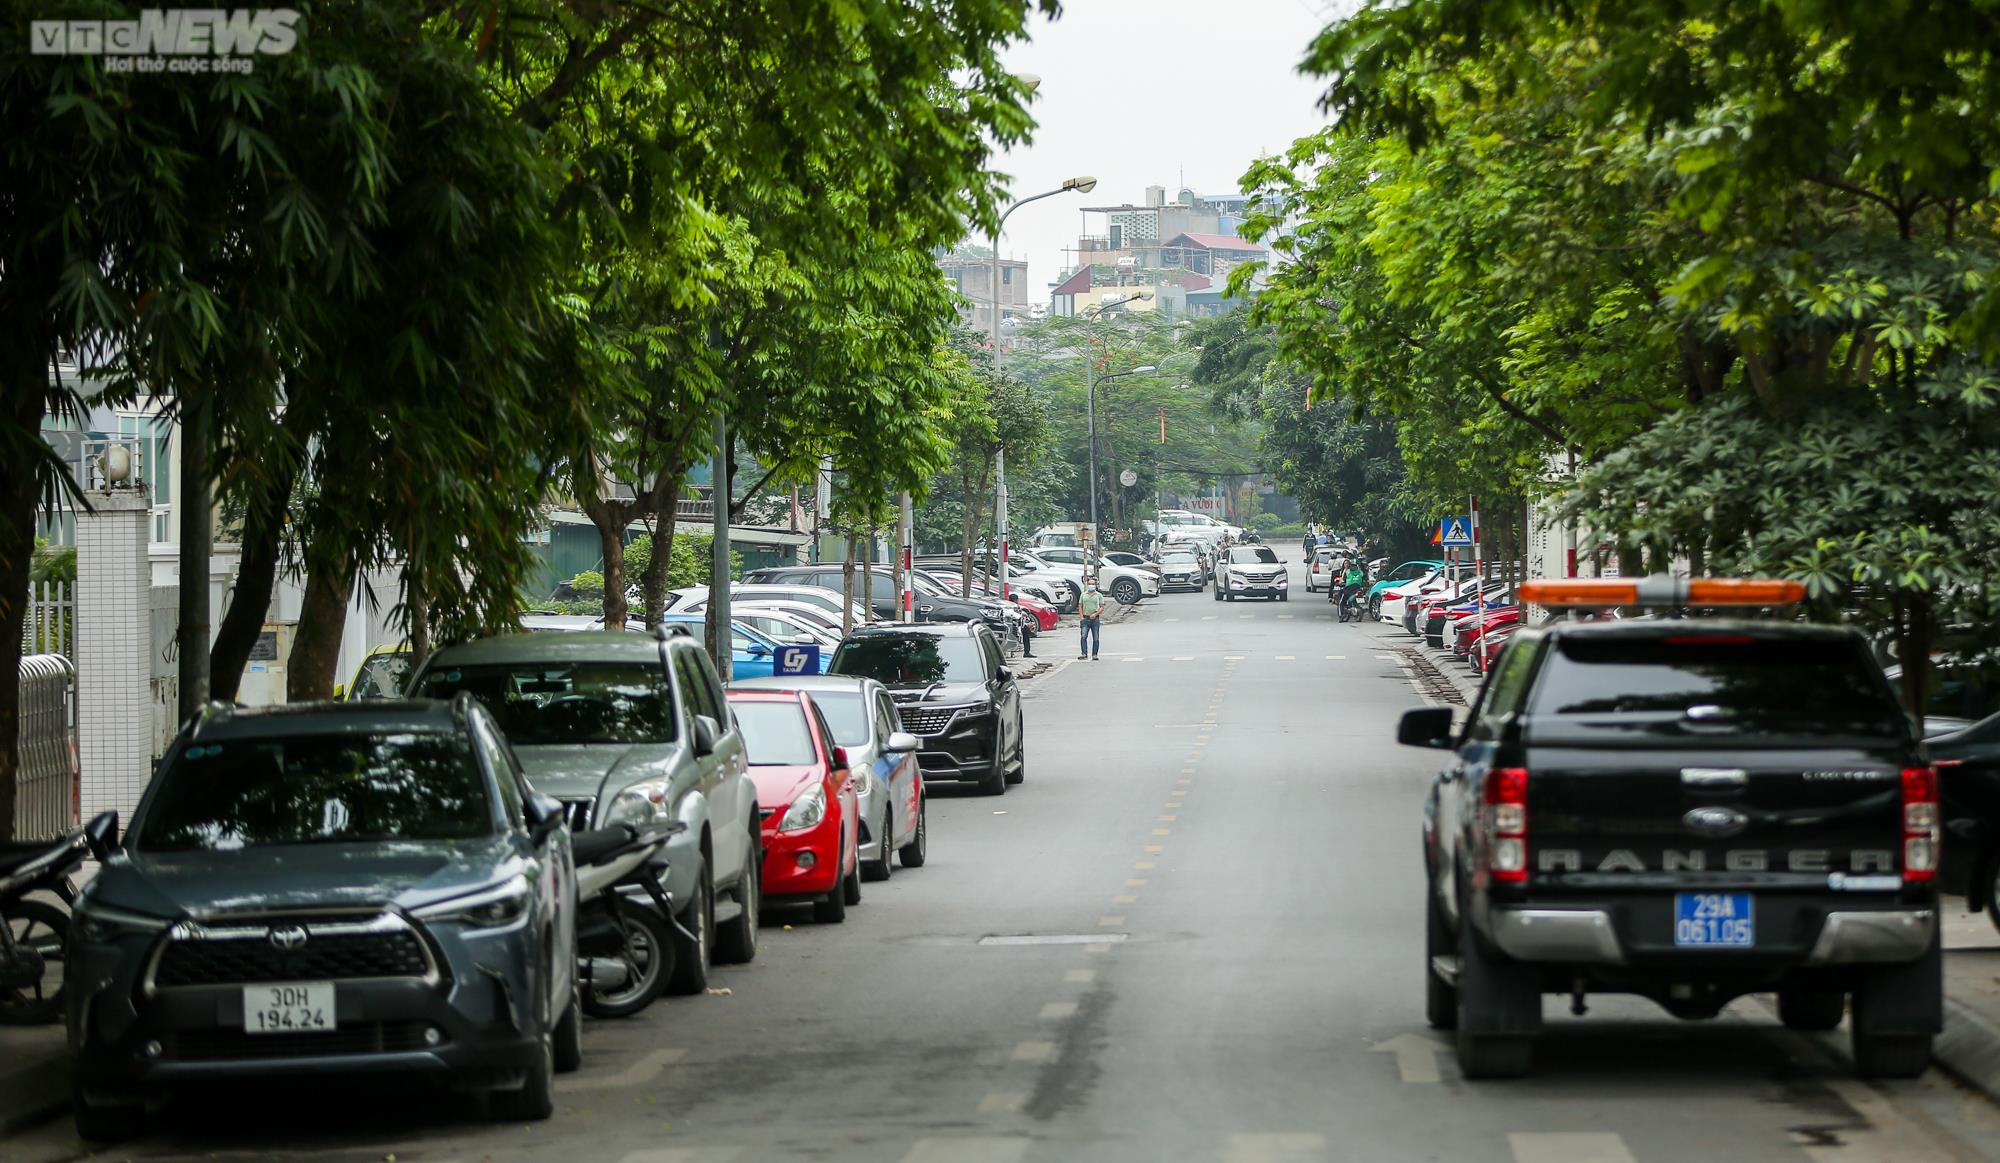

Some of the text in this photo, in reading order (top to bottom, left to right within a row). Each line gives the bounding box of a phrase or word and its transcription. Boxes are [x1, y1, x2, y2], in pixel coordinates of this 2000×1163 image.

[784, 648, 808, 672] G7
[1538, 849, 1894, 872] RANGER
[1693, 894, 1735, 917] 29A
[270, 987, 308, 1007] 30H
[257, 1008, 324, 1028] 194.24
